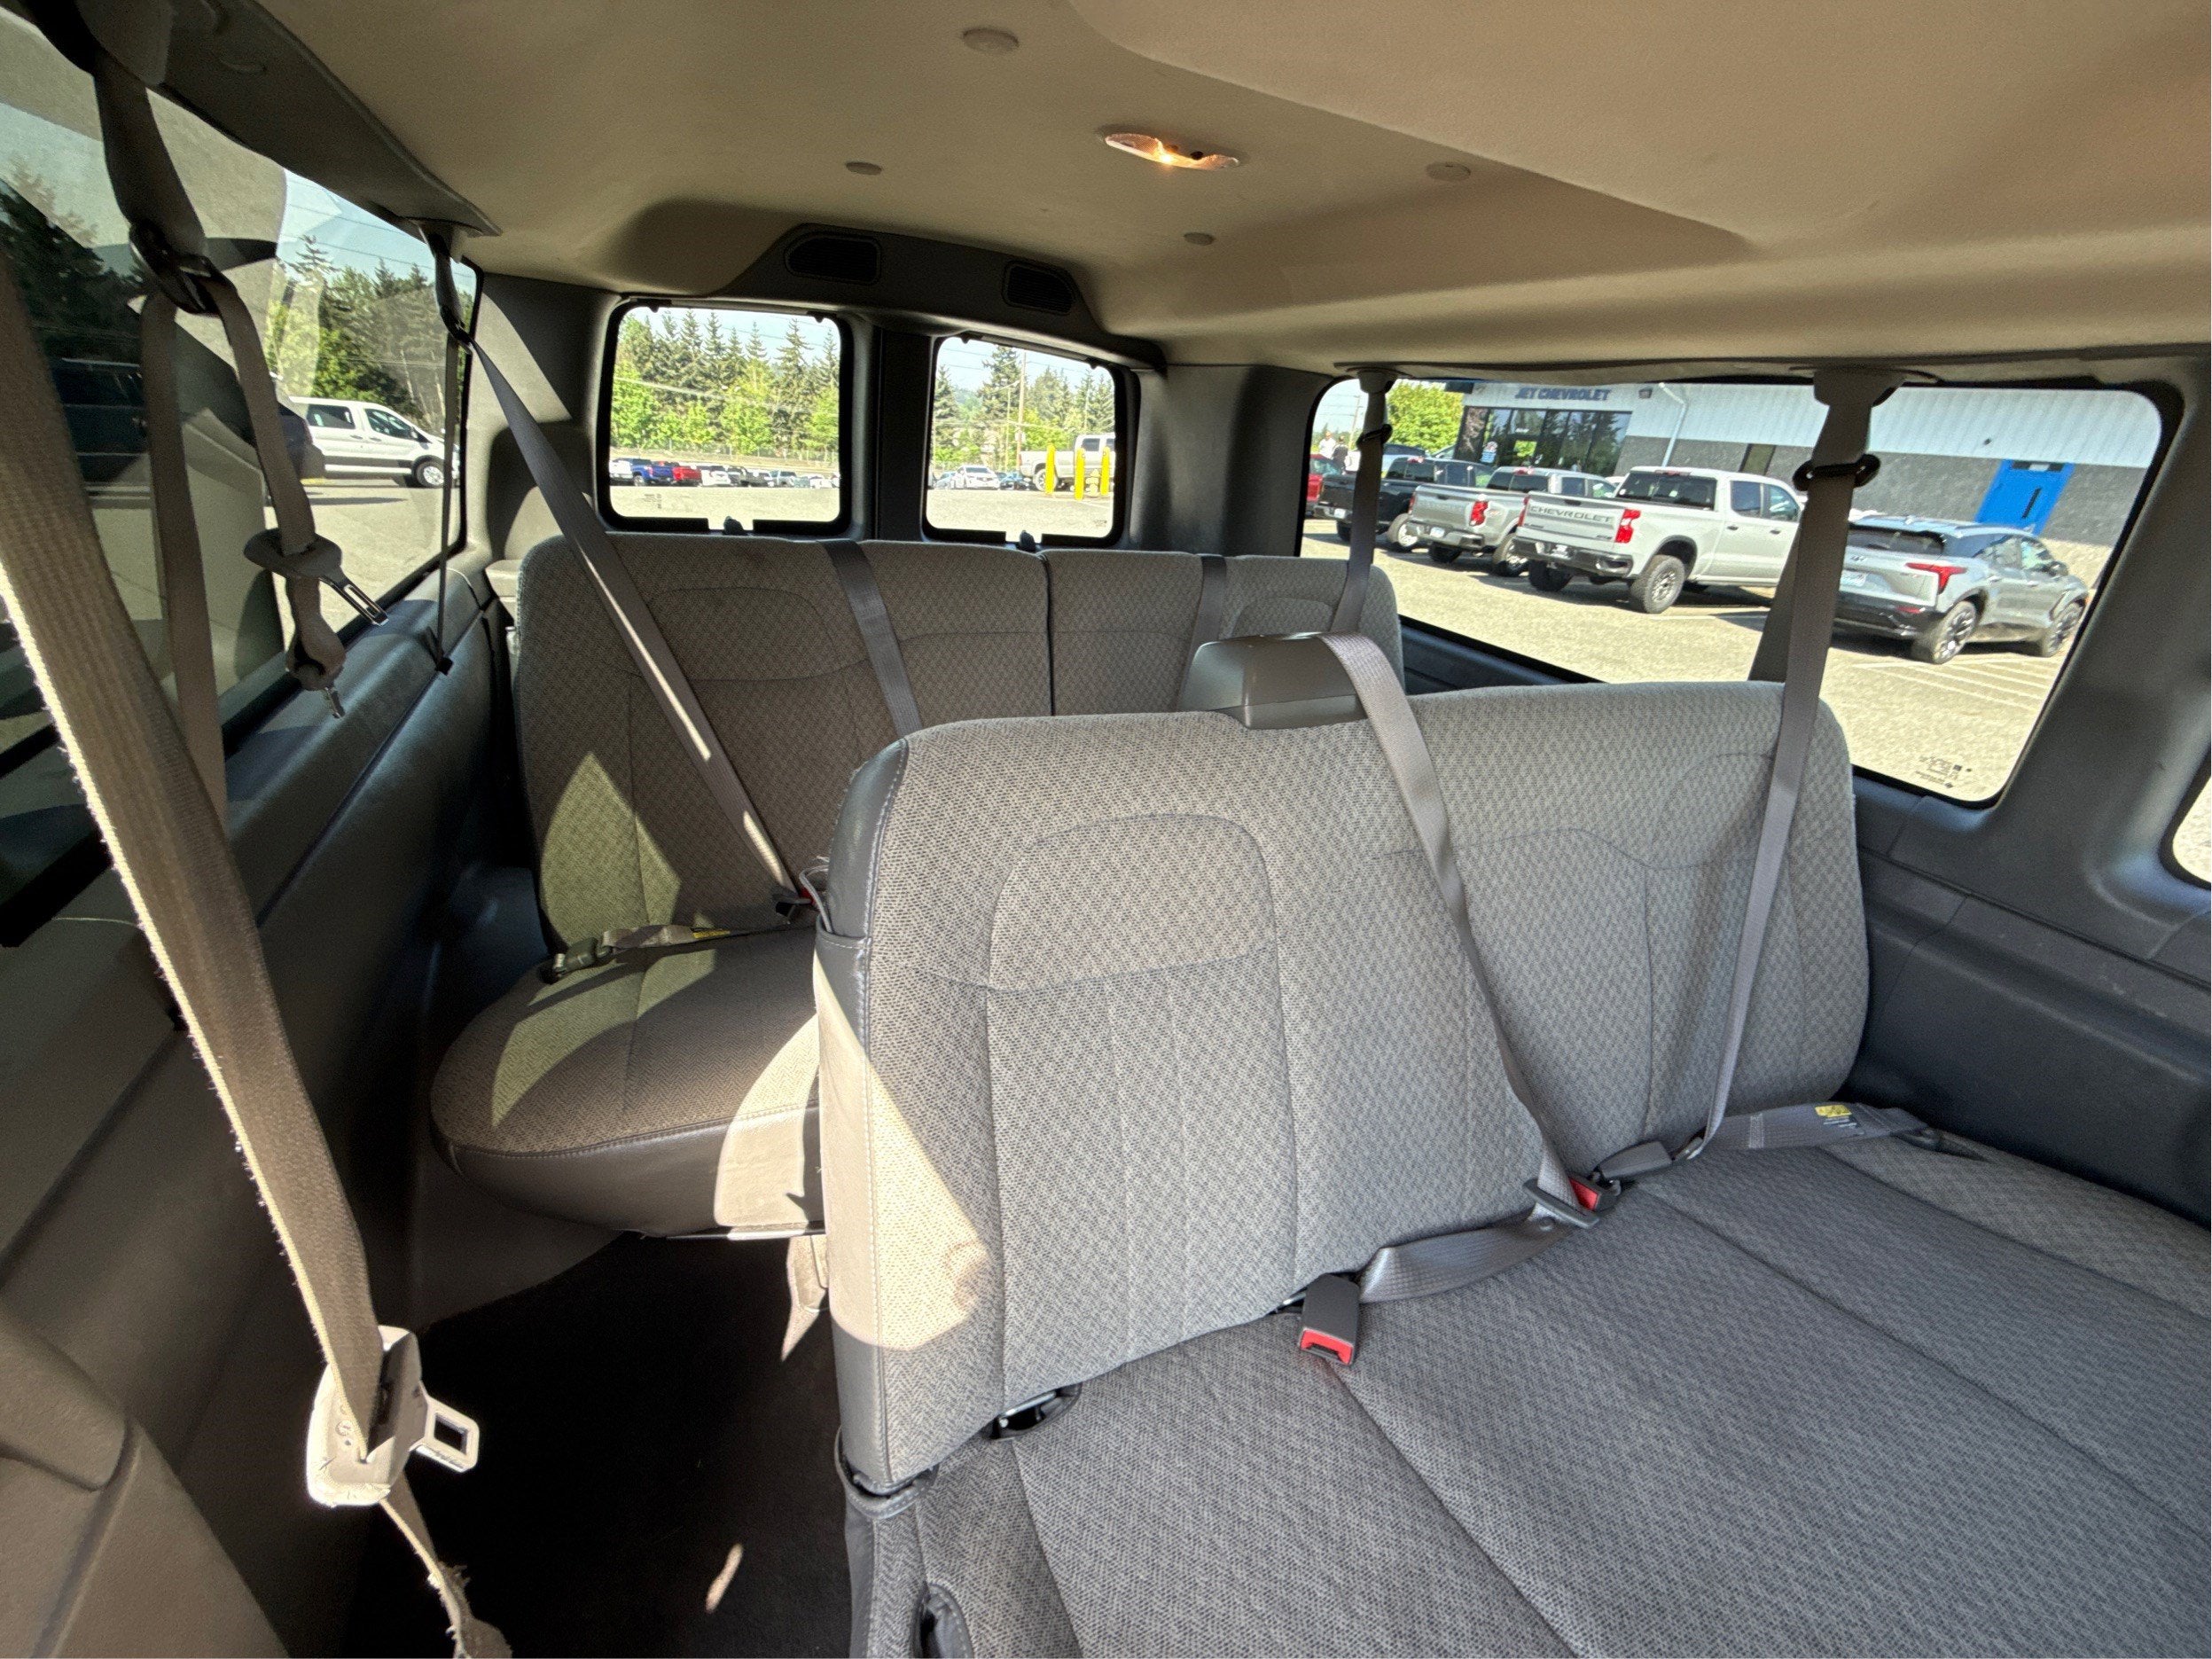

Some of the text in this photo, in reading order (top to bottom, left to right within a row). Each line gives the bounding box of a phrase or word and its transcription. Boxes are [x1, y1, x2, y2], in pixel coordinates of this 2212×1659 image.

[1515, 387, 1611, 401] JET CHEVROLET
[1529, 505, 1614, 523] CHEVROLET
